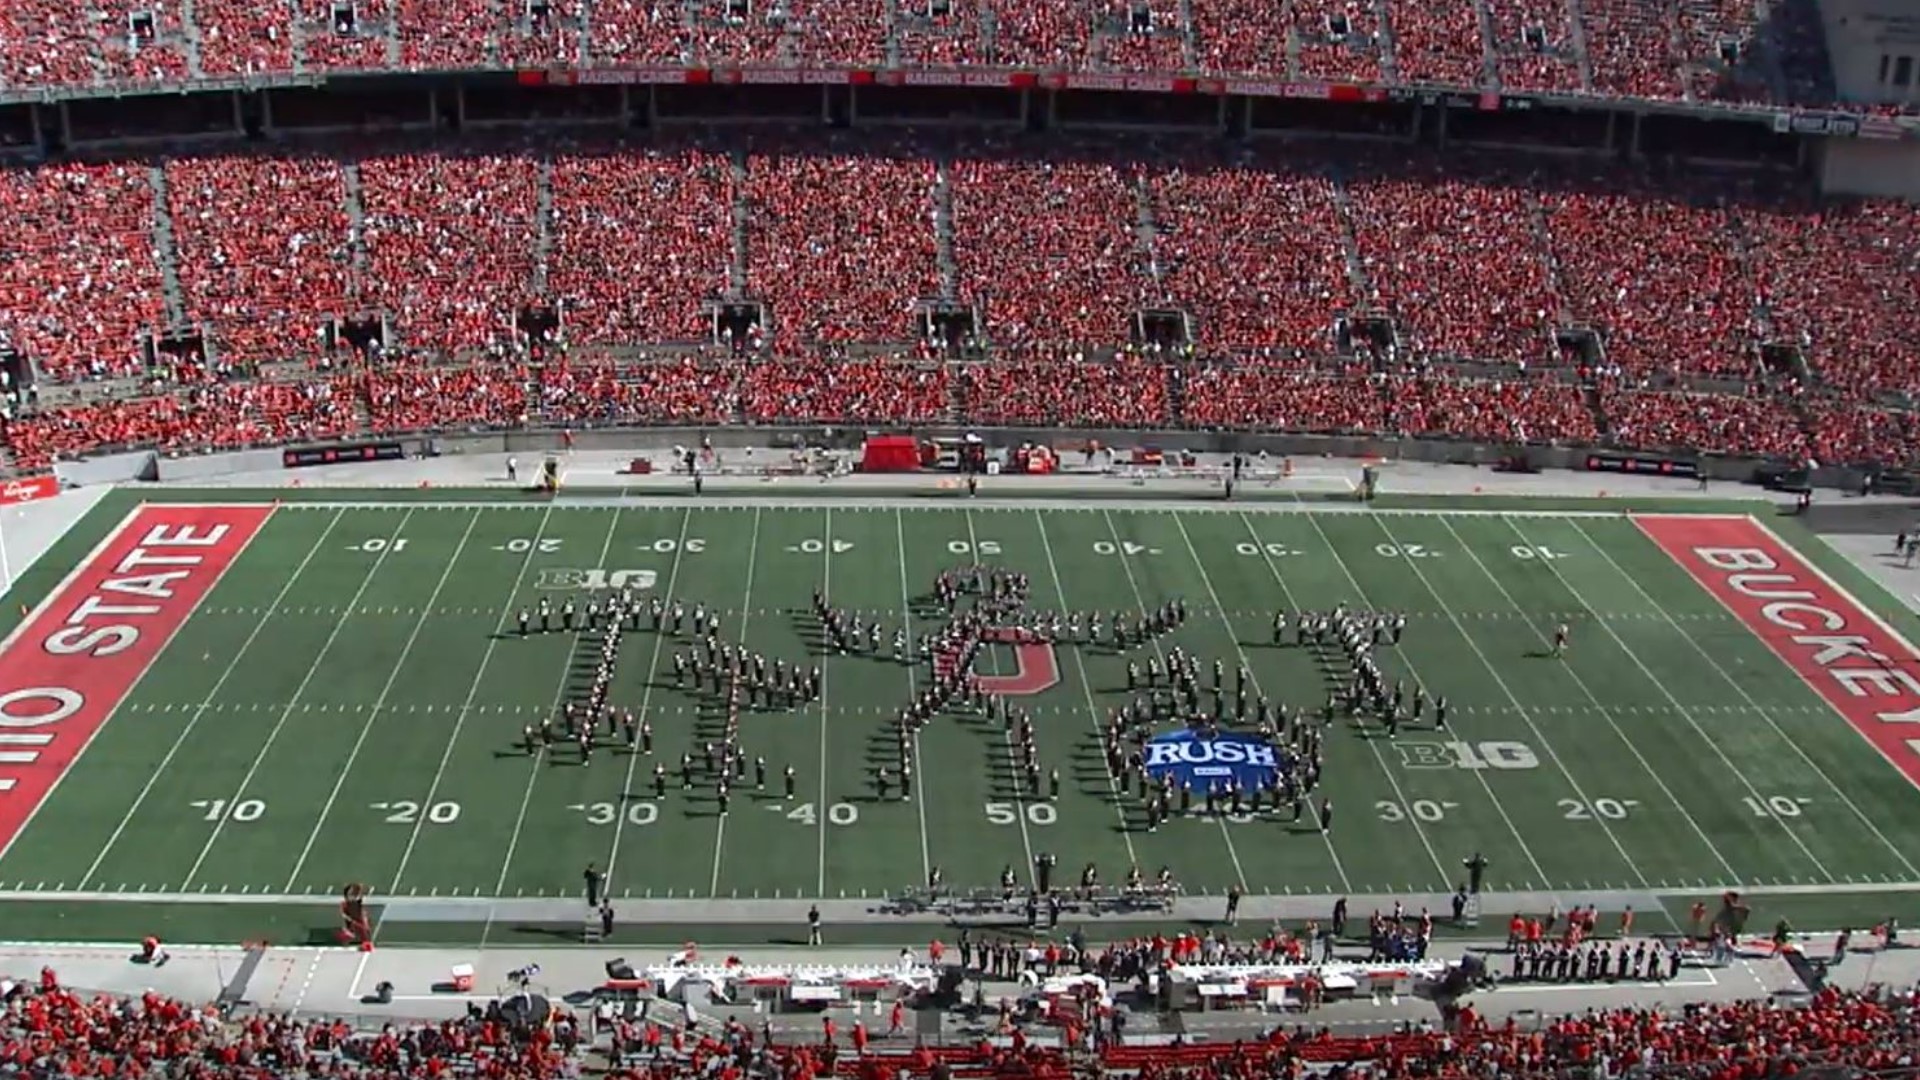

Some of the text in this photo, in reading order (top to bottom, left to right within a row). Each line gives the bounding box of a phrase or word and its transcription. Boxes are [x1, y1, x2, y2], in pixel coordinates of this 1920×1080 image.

[43, 523, 231, 657] STATE
[1147, 739, 1277, 767] RUSH
[204, 799, 266, 821] 10
[385, 801, 461, 823] 20
[587, 802, 658, 824] 30
[786, 802, 859, 824] 40
[985, 802, 1057, 825] 50
[1375, 800, 1444, 822] 30
[1557, 798, 1628, 819] 20
[1742, 796, 1801, 817] 10
